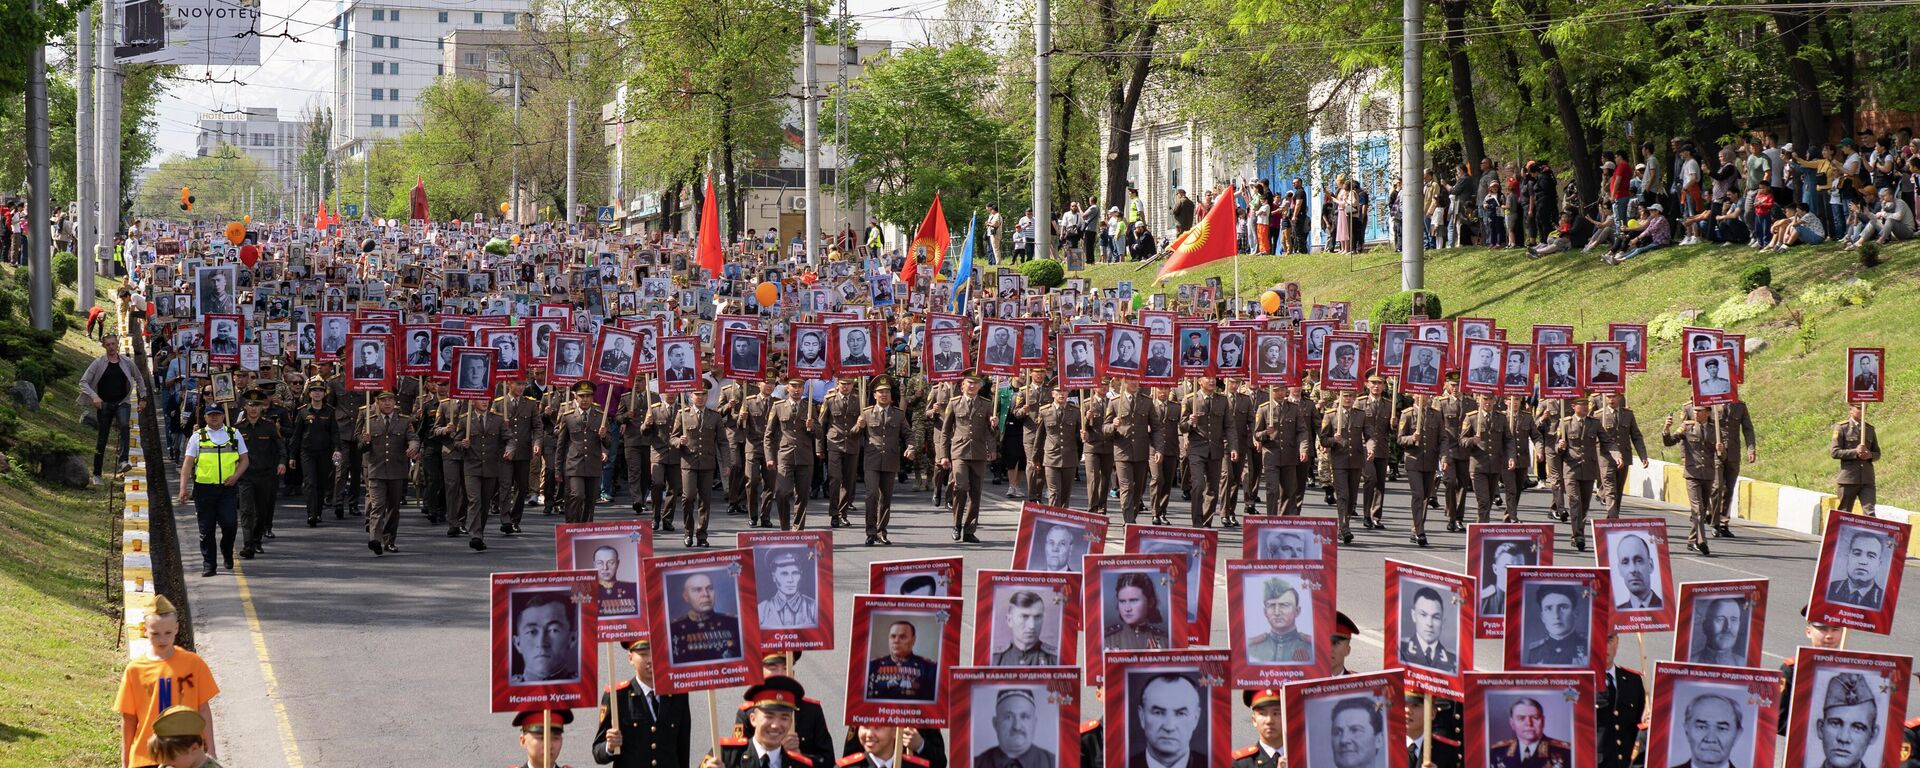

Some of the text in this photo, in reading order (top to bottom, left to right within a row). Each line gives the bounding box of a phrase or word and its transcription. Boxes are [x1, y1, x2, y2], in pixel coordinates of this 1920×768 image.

[178, 8, 257, 18] NOVOTEL
[1205, 654, 1229, 662] СЛАВЫ
[1835, 656, 1873, 667] СОВЕТСКОГО
[668, 665, 748, 680] Тимошенко Семён
[954, 672, 984, 680] ПОЛНЫЙ
[986, 672, 1017, 680] КАВАЛЕР
[1019, 672, 1052, 680] ОРДЕНОВ
[1658, 667, 1779, 683] ПОЛНЫЙ КАВАЛЕР ОРДЕНОВ СЛАВЫ
[674, 676, 745, 689] Константинович
[1300, 678, 1388, 696] ГЕРОЙ СОВЕТСКОГО СОЮЗА
[509, 692, 581, 703] Исманов Хусаин
[878, 707, 922, 716] Мерецков
[852, 716, 946, 725] Кирилл Афанасьевич
